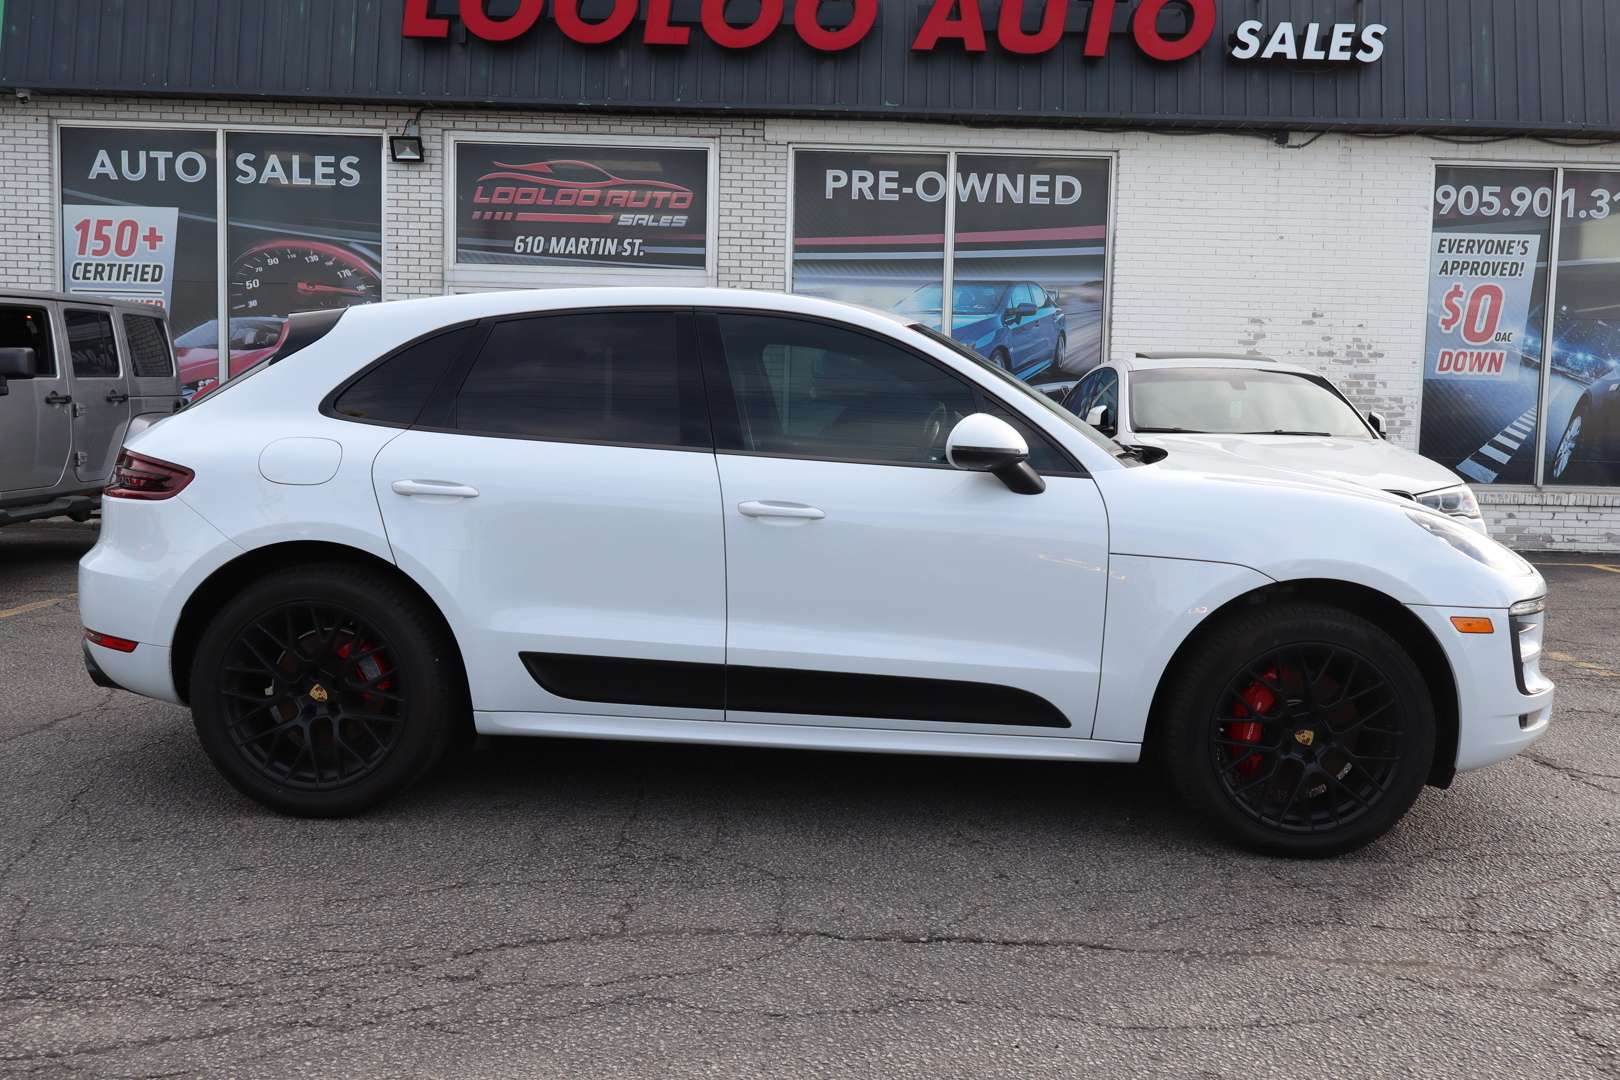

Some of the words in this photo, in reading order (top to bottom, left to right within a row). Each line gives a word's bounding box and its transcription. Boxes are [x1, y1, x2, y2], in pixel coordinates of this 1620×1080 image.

[1230, 19, 1388, 64] SALES
[88, 149, 207, 183] AUTO
[235, 152, 361, 187] SALES
[473, 186, 600, 207] LOOLOO
[604, 190, 693, 209] AUTO
[825, 169, 1082, 205] PRE-OWNED
[1435, 184, 1620, 219] 905.901.3
[617, 214, 689, 227] SALES
[74, 218, 164, 257] 150+
[514, 235, 544, 254] 610
[549, 236, 618, 256] MARTIN
[622, 238, 645, 256] ST.
[1437, 237, 1529, 256] EVERYONE'S
[71, 262, 164, 282] CERTIFIED
[267, 257, 280, 266] 90
[1439, 259, 1525, 277] APPROVED!
[245, 278, 260, 290] 50
[1440, 283, 1503, 343] $0
[1494, 331, 1512, 343] OAC
[1437, 350, 1504, 373] DOWN
